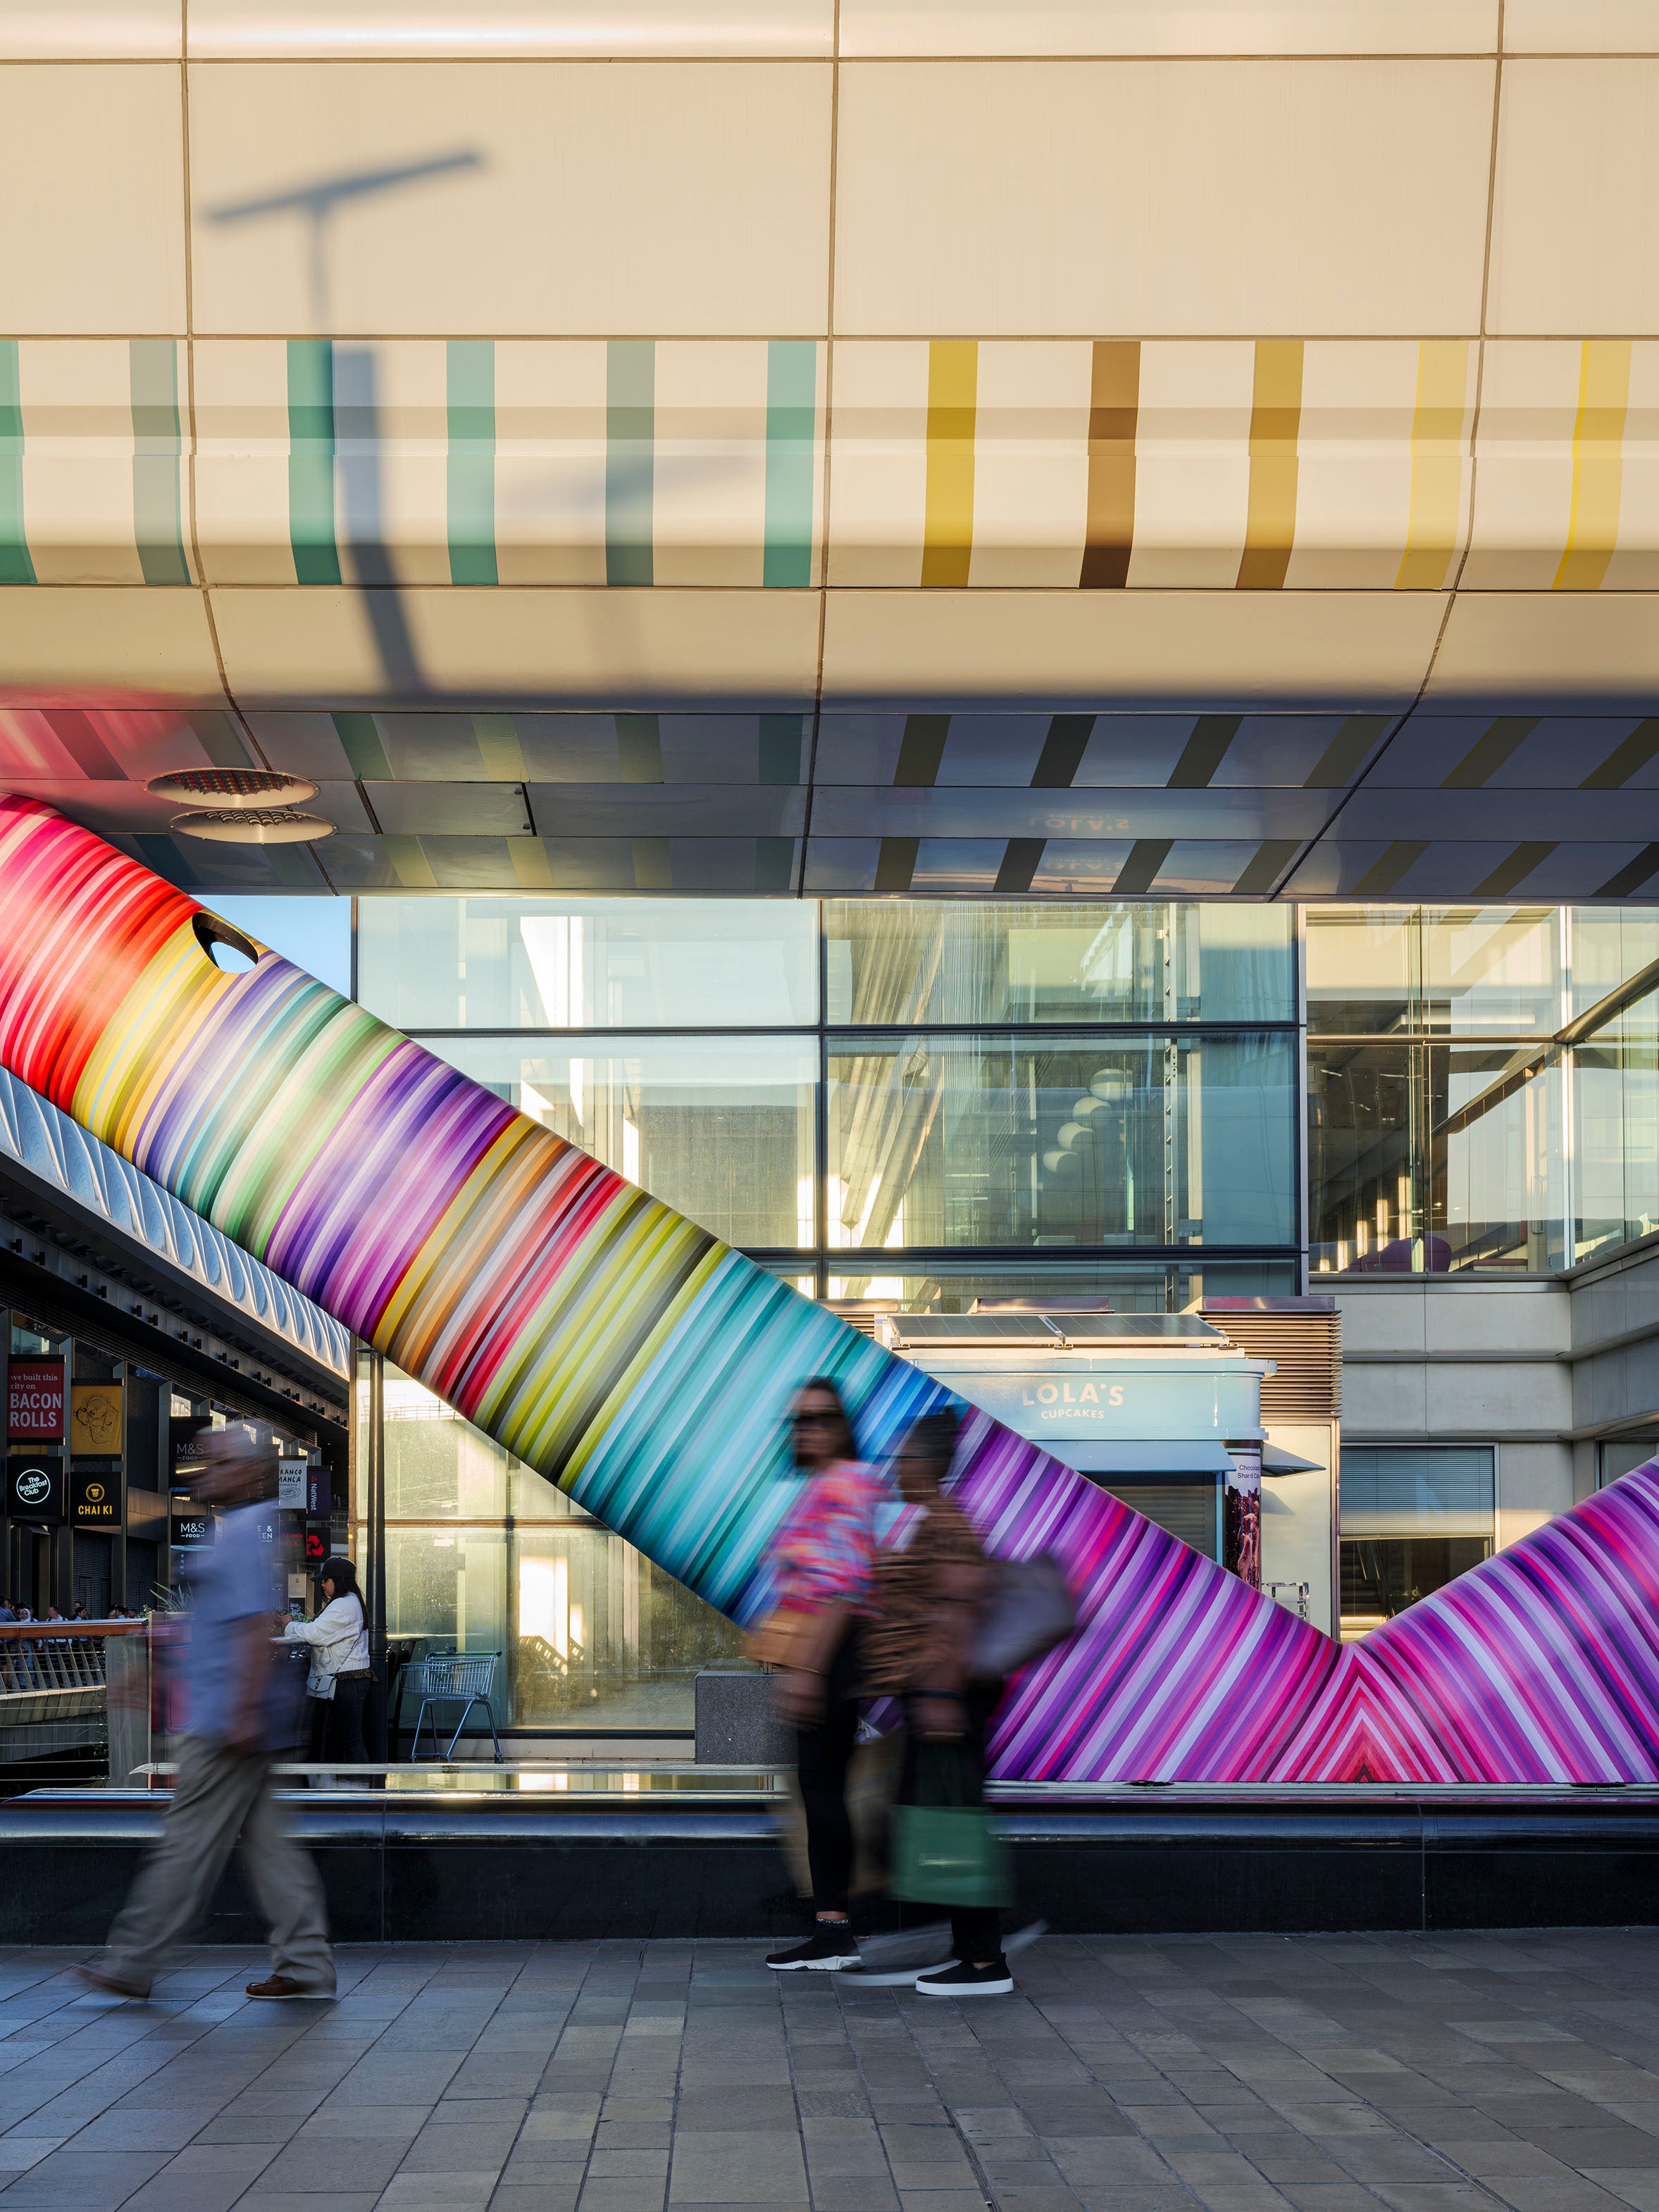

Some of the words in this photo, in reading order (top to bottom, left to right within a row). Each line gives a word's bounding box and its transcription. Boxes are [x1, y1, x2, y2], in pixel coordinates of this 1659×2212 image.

[11, 1382, 25, 1391] city
[1021, 1382, 1124, 1406] LOLA'S
[10, 1393, 62, 1409] BACON
[10, 1411, 57, 1427] ROLLS
[1040, 1409, 1105, 1419] CUPCAKES
[177, 1443, 204, 1455] M&S
[19, 1479, 48, 1492] Breakfast
[24, 1488, 39, 1496] Club
[78, 1505, 100, 1515] CHAI
[103, 1505, 113, 1515] KI
[180, 1522, 205, 1533] M&S
